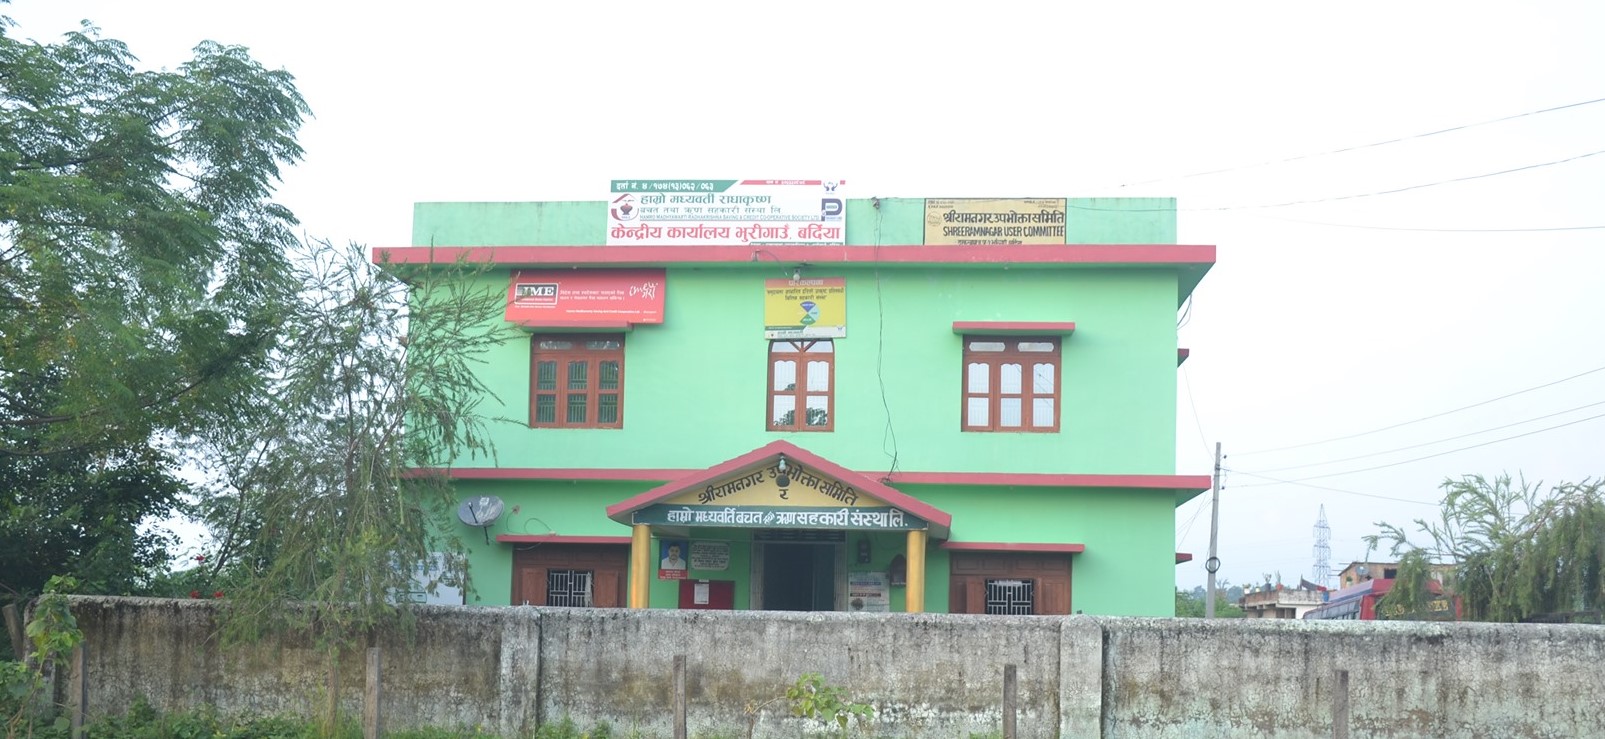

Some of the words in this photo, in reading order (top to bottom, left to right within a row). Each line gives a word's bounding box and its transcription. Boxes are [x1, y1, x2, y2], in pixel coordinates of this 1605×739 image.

[640, 193, 666, 205] हाम्रो
[670, 193, 714, 205] मध्यवर्ती
[719, 195, 771, 206] राधाकृष्ण
[684, 207, 703, 215] ऋण
[707, 206, 739, 214] सहकारी
[744, 206, 766, 214] संस्था
[1031, 209, 1065, 223] समिति
[611, 223, 662, 240] केन्द्रीय
[667, 224, 730, 239] कार्यालय
[797, 223, 841, 240] बर्दिया
[943, 226, 1002, 237] SHREERAMNAGAR
[1004, 226, 1022, 237] USER
[1023, 226, 1064, 237] COMMITTEE
[779, 489, 789, 500] र
[819, 480, 859, 506] समिति
[667, 507, 694, 523] हाम्रो
[736, 511, 763, 524] बचत
[776, 511, 795, 525] ऋण
[796, 508, 849, 526] सहकारी
[850, 510, 888, 527] संस्था
